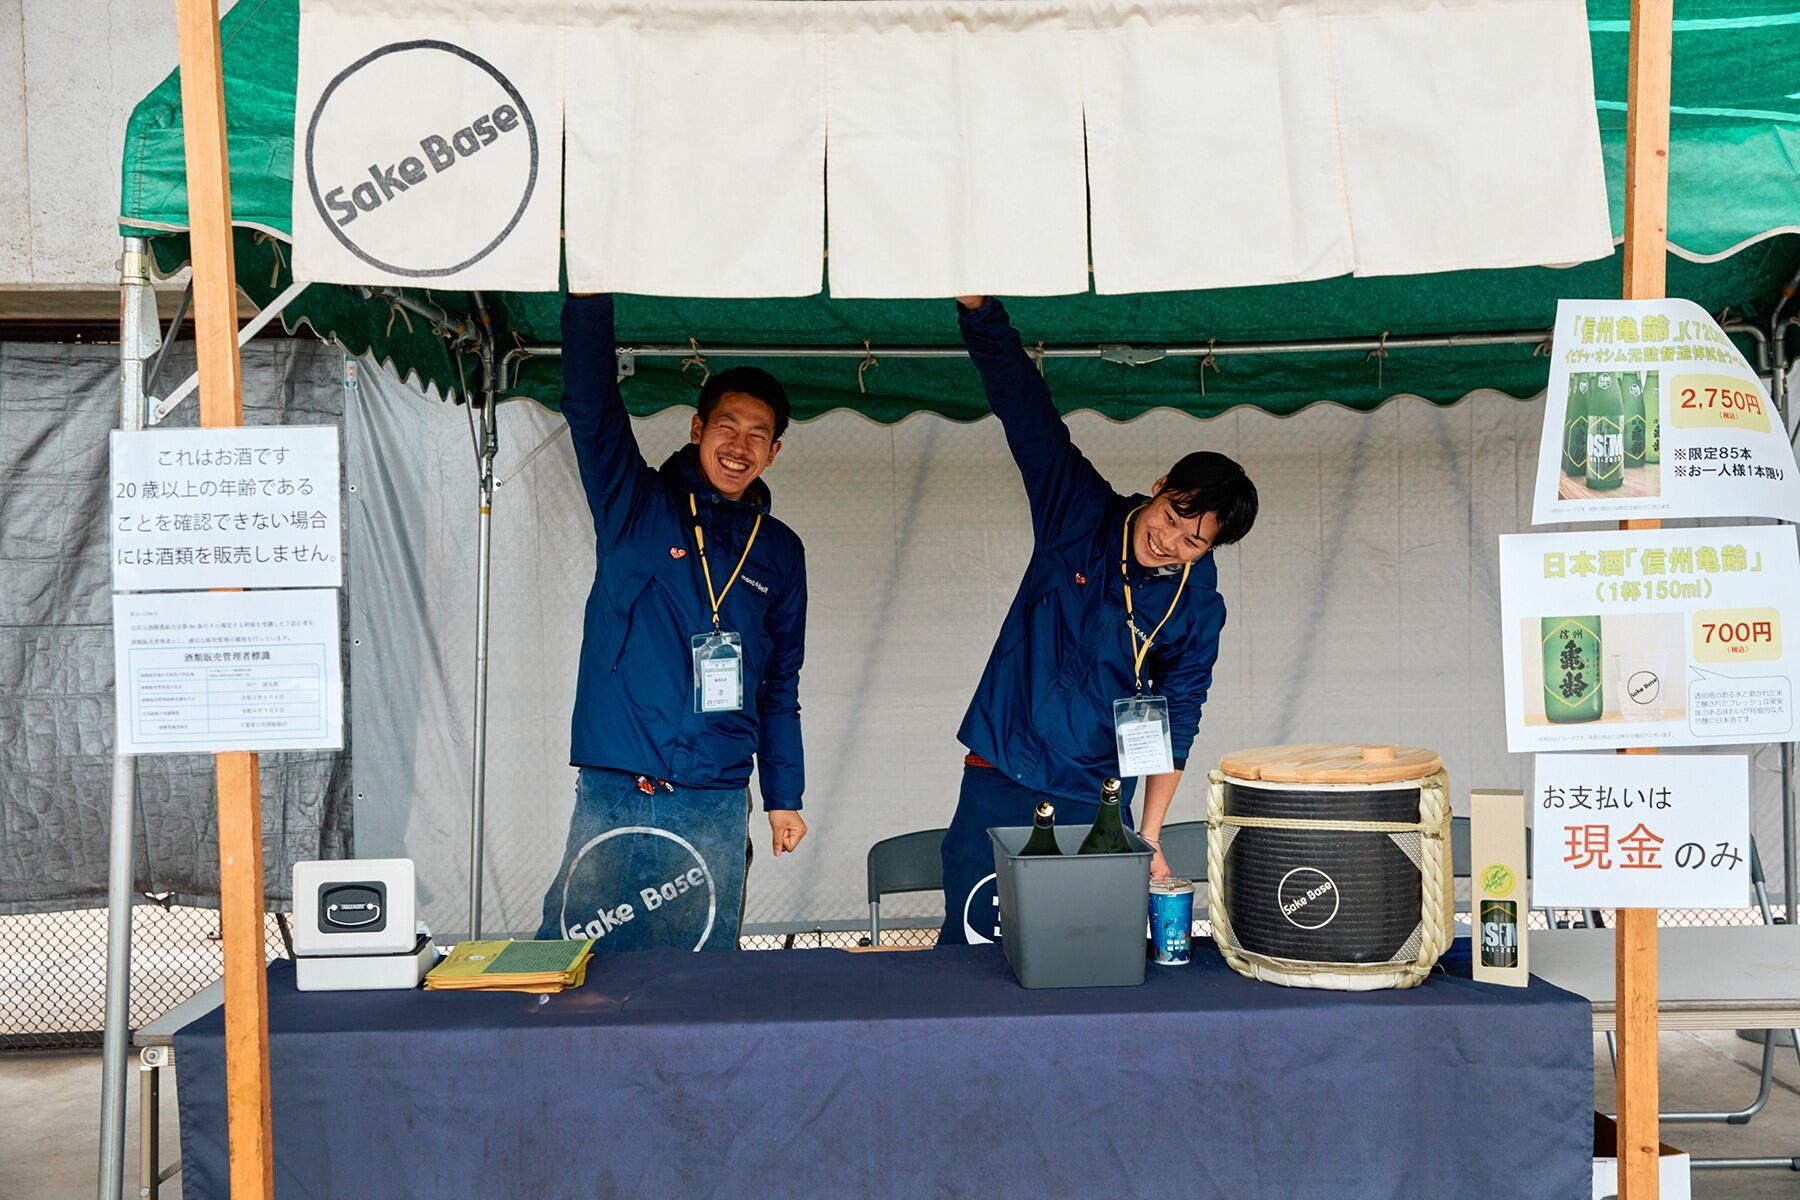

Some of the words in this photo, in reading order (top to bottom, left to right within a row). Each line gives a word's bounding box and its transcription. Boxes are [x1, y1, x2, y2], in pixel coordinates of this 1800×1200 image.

[324, 156, 428, 227] Sake
[419, 104, 520, 174] Base
[1680, 388, 1762, 416] 2,750円
[158, 447, 290, 466] これはお酒です
[1674, 446, 1753, 461] ※限定85本
[1674, 464, 1785, 482] ※お一人様1本限り
[118, 510, 328, 532] ことを確認できない場合
[118, 544, 336, 566] には酒類を販売しません。
[1542, 544, 1762, 578] 日本酒「信州亀齢」
[1595, 578, 1713, 602] （1杯150ml）
[1559, 629, 1584, 640] 信州
[1701, 621, 1773, 644] 700円
[184, 650, 271, 663] 酒類販売管理者標識
[1542, 784, 1673, 811] お支払いは
[568, 903, 635, 940] Sake
[640, 866, 705, 912] Base
[1283, 897, 1308, 915] Sake
[1306, 881, 1333, 901] Base
